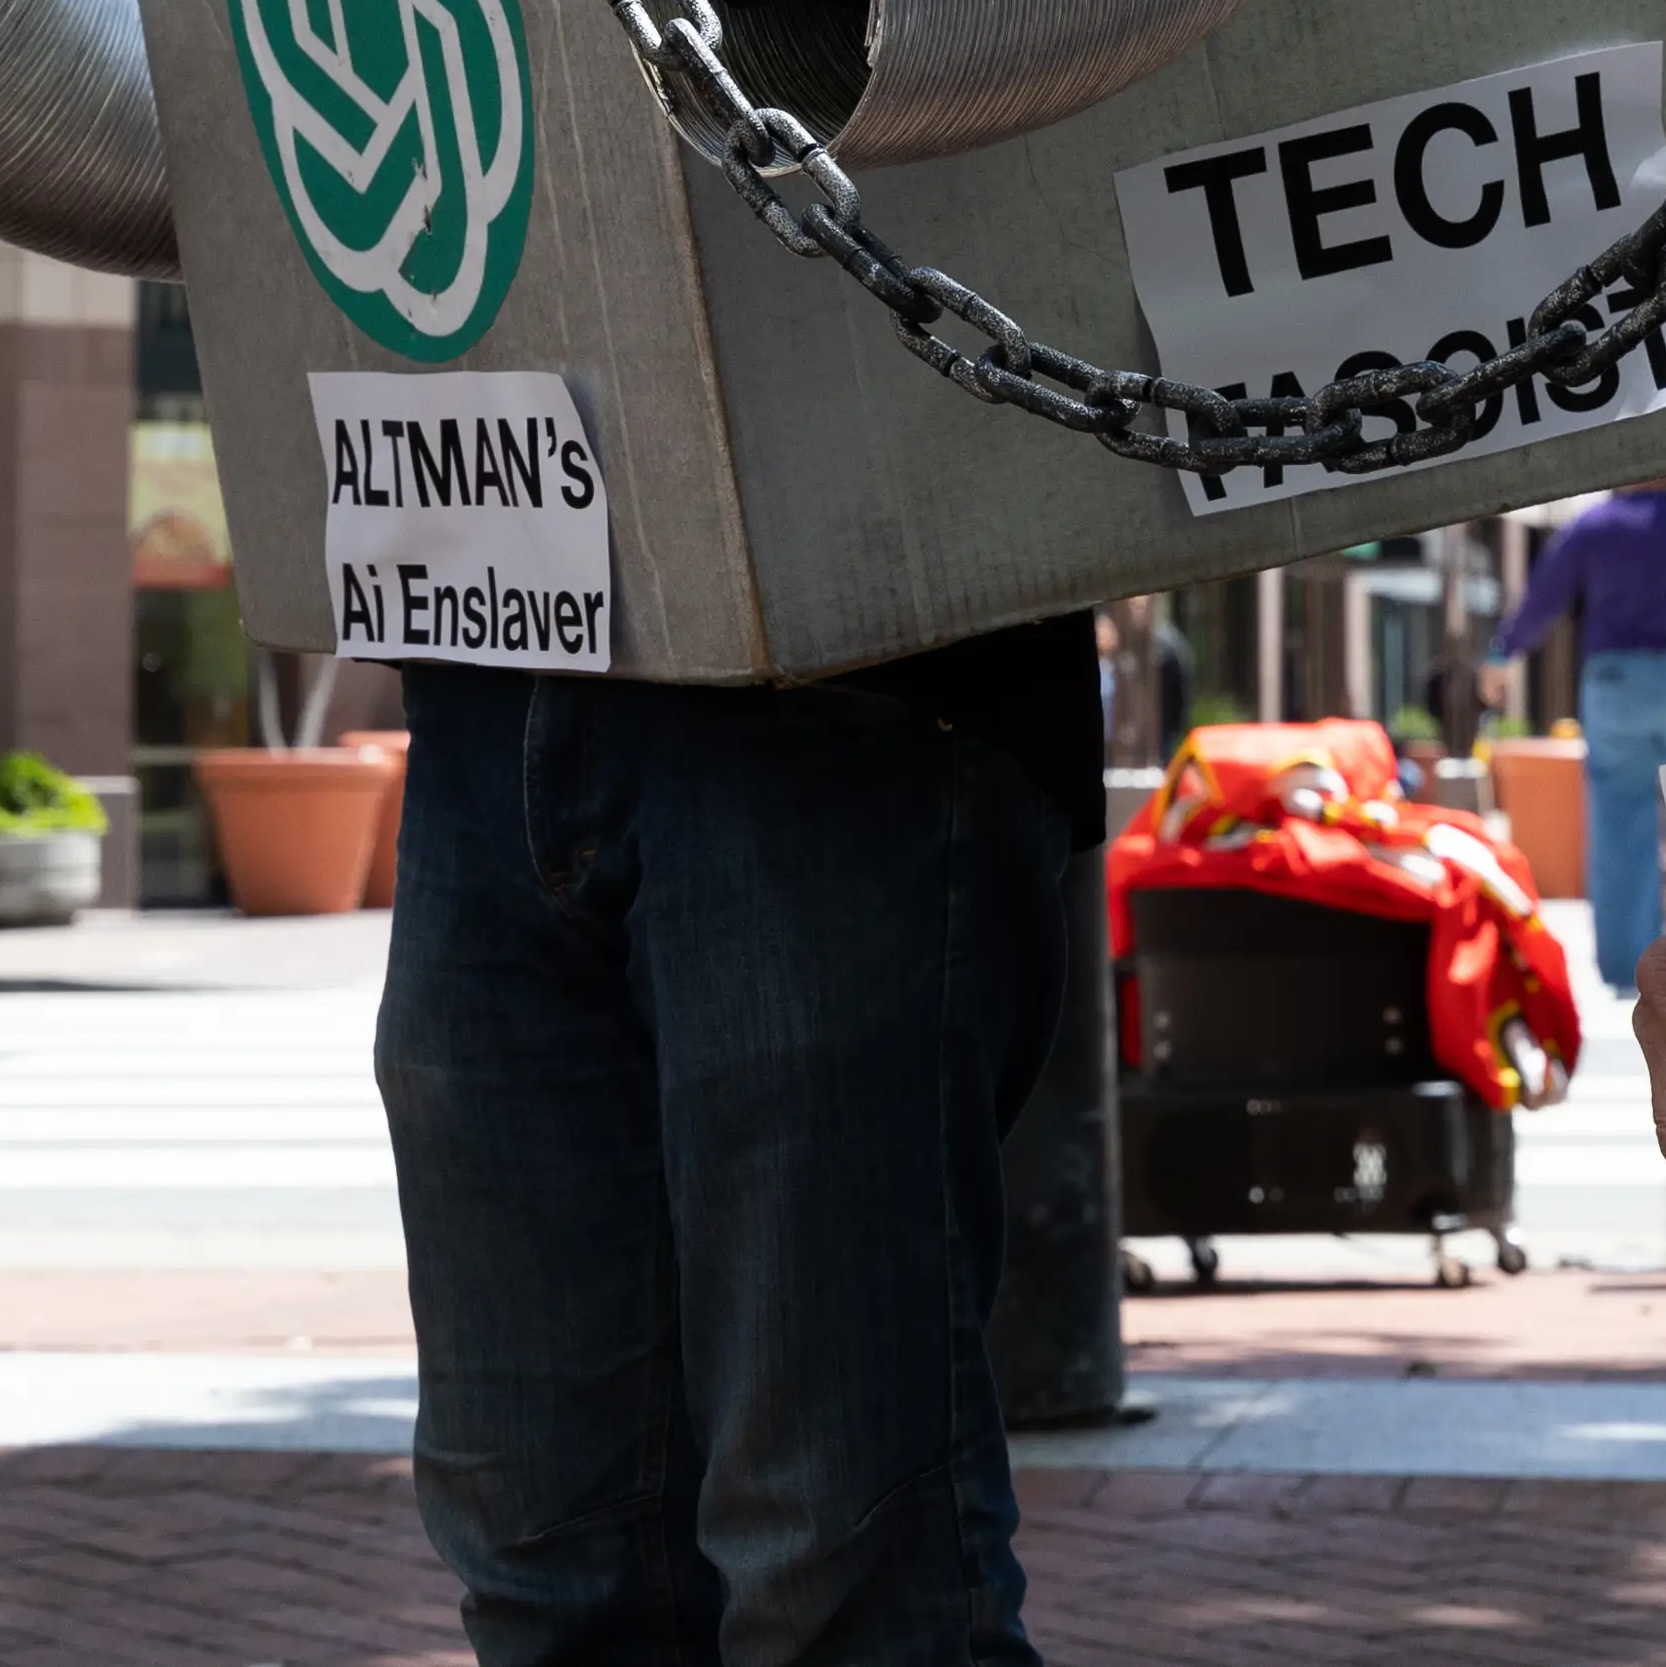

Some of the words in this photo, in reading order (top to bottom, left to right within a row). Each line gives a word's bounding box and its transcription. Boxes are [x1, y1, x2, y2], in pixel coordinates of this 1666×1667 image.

[1163, 71, 1623, 298] TECH
[332, 416, 596, 510] ALTMAN's
[342, 562, 386, 643] Ai
[396, 563, 604, 656] Enslaver
